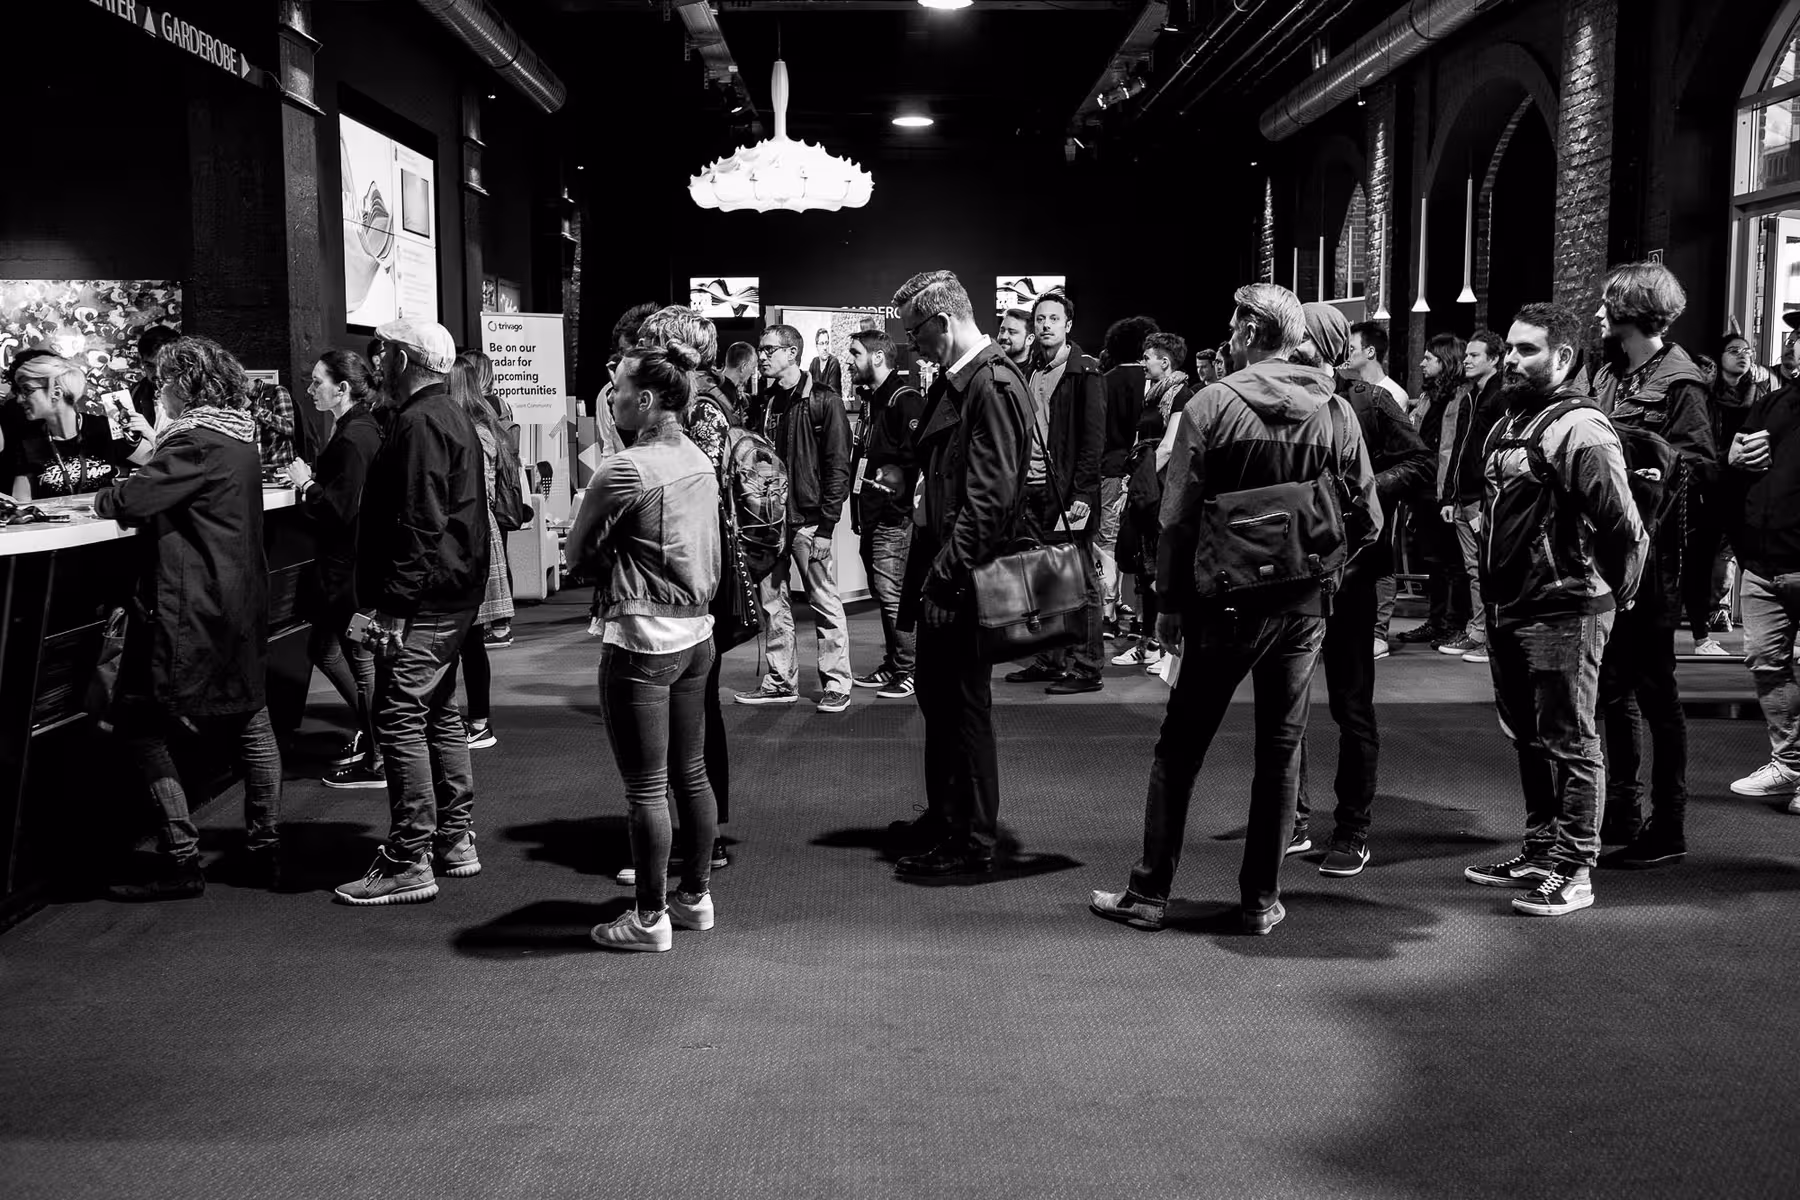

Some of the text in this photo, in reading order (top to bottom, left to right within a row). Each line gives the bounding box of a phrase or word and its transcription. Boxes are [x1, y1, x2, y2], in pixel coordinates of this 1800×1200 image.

[161, 12, 238, 75] GARDEROBE
[498, 322, 522, 332] trivago
[489, 342, 537, 353] Be on our
[518, 356, 532, 367] for
[492, 385, 556, 398] opportunities
